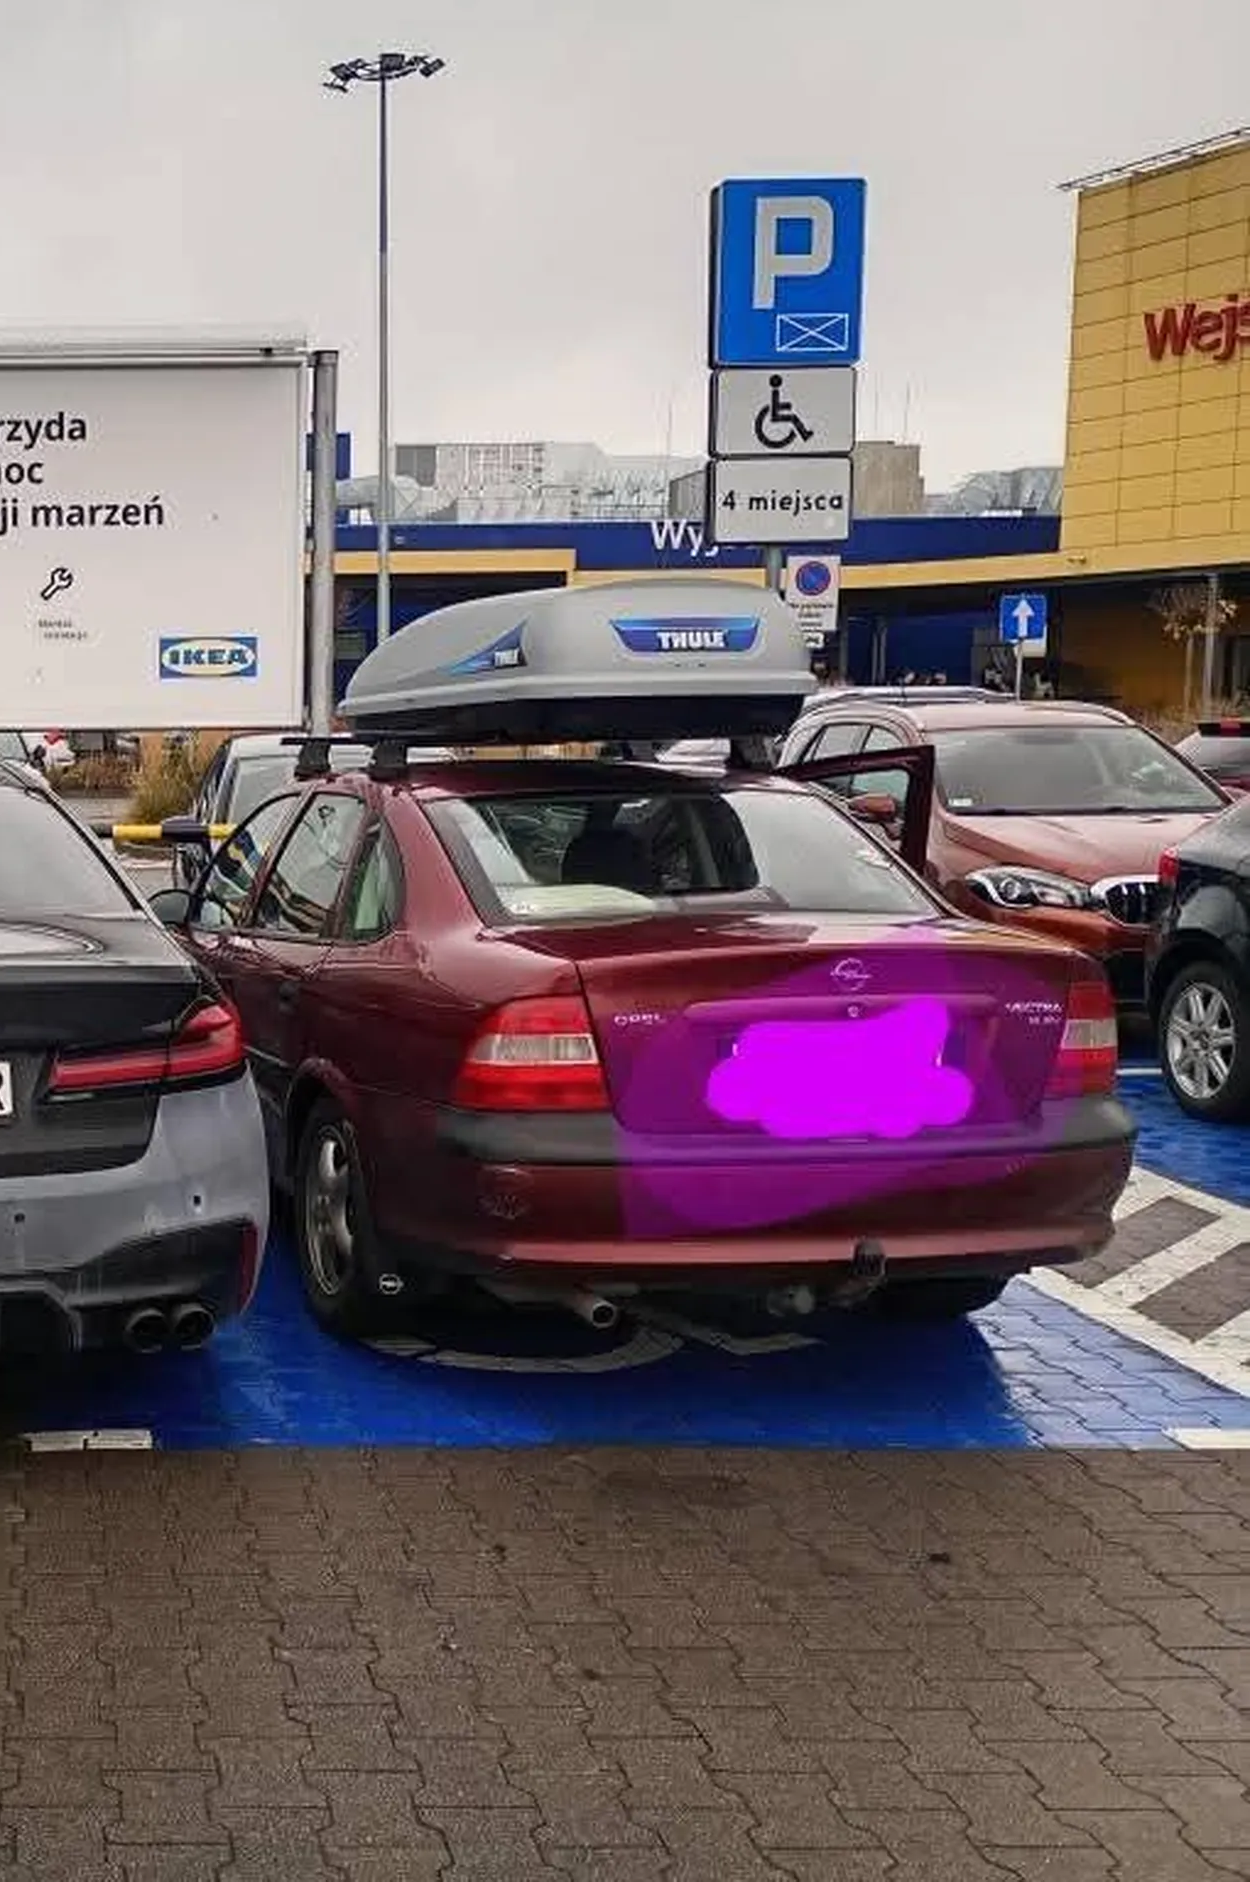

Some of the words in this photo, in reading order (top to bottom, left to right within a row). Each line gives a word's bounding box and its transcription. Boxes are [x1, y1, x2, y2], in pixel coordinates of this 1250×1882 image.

[752, 195, 834, 310] P
[31, 495, 165, 529] marzeń
[722, 489, 736, 511] 4
[749, 489, 843, 516] miejsca
[656, 630, 726, 649] THULE
[170, 648, 248, 665] IKEA
